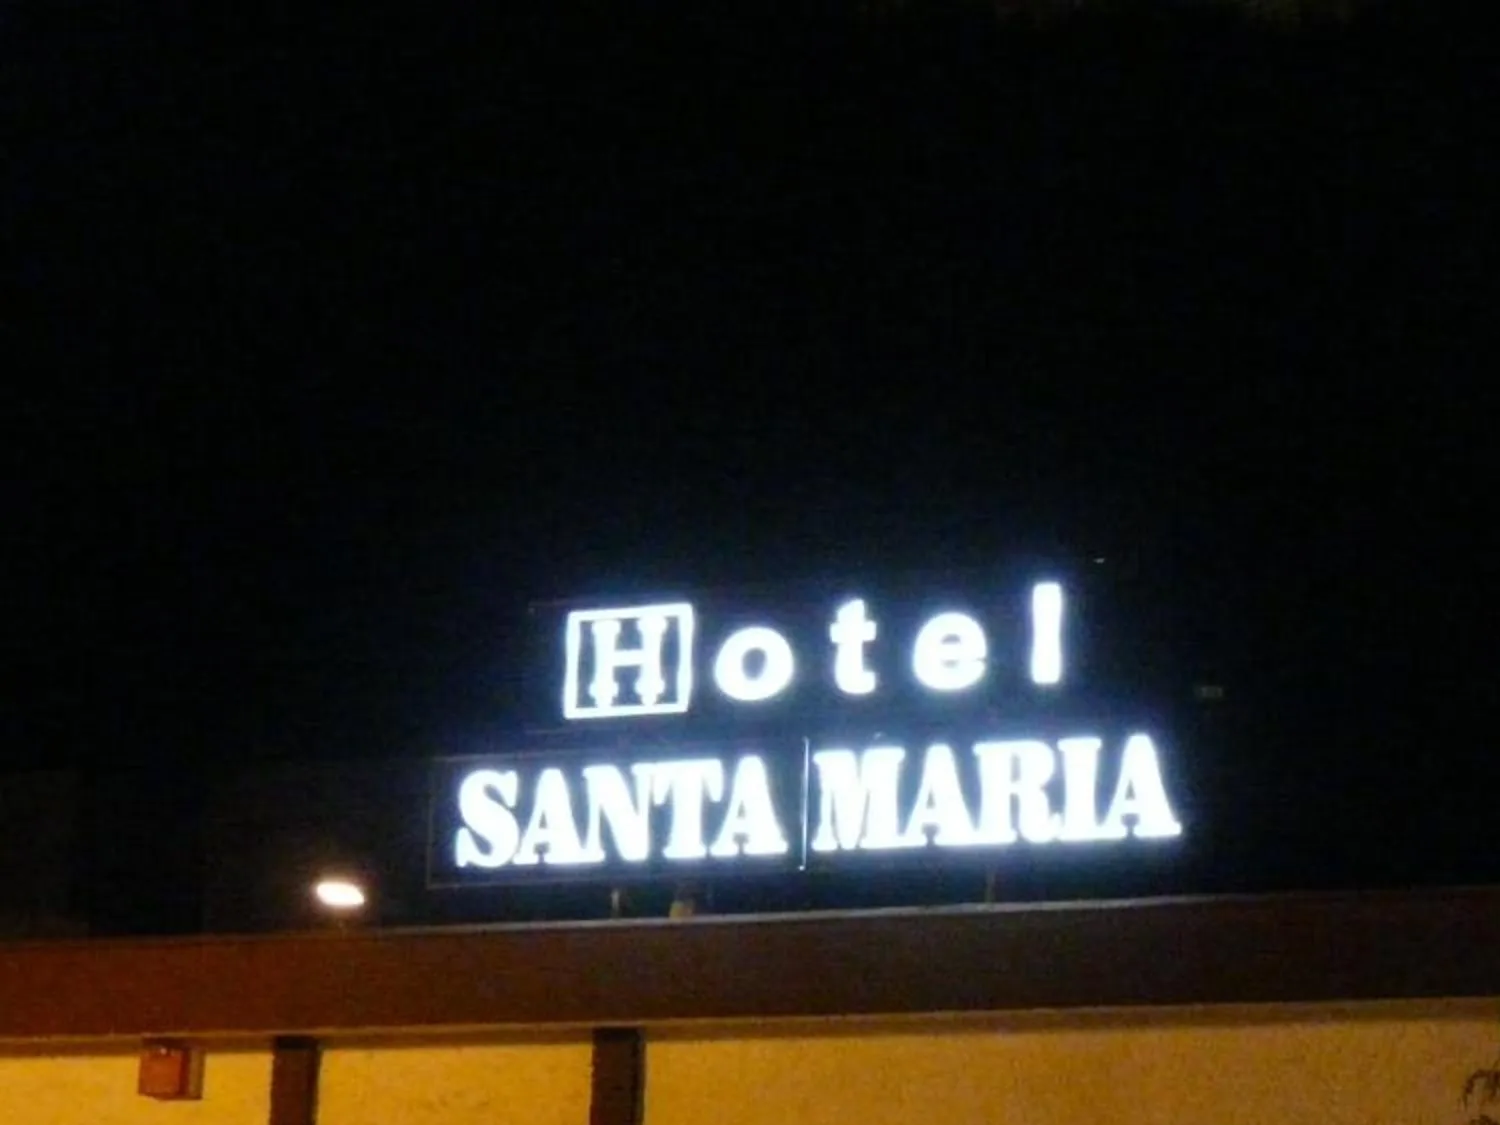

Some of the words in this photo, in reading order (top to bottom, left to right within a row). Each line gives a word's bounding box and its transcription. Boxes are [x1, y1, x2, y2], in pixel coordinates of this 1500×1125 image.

[586, 581, 1064, 710] Hotel
[455, 754, 789, 868] SANTA
[811, 733, 1182, 853] MARIA
